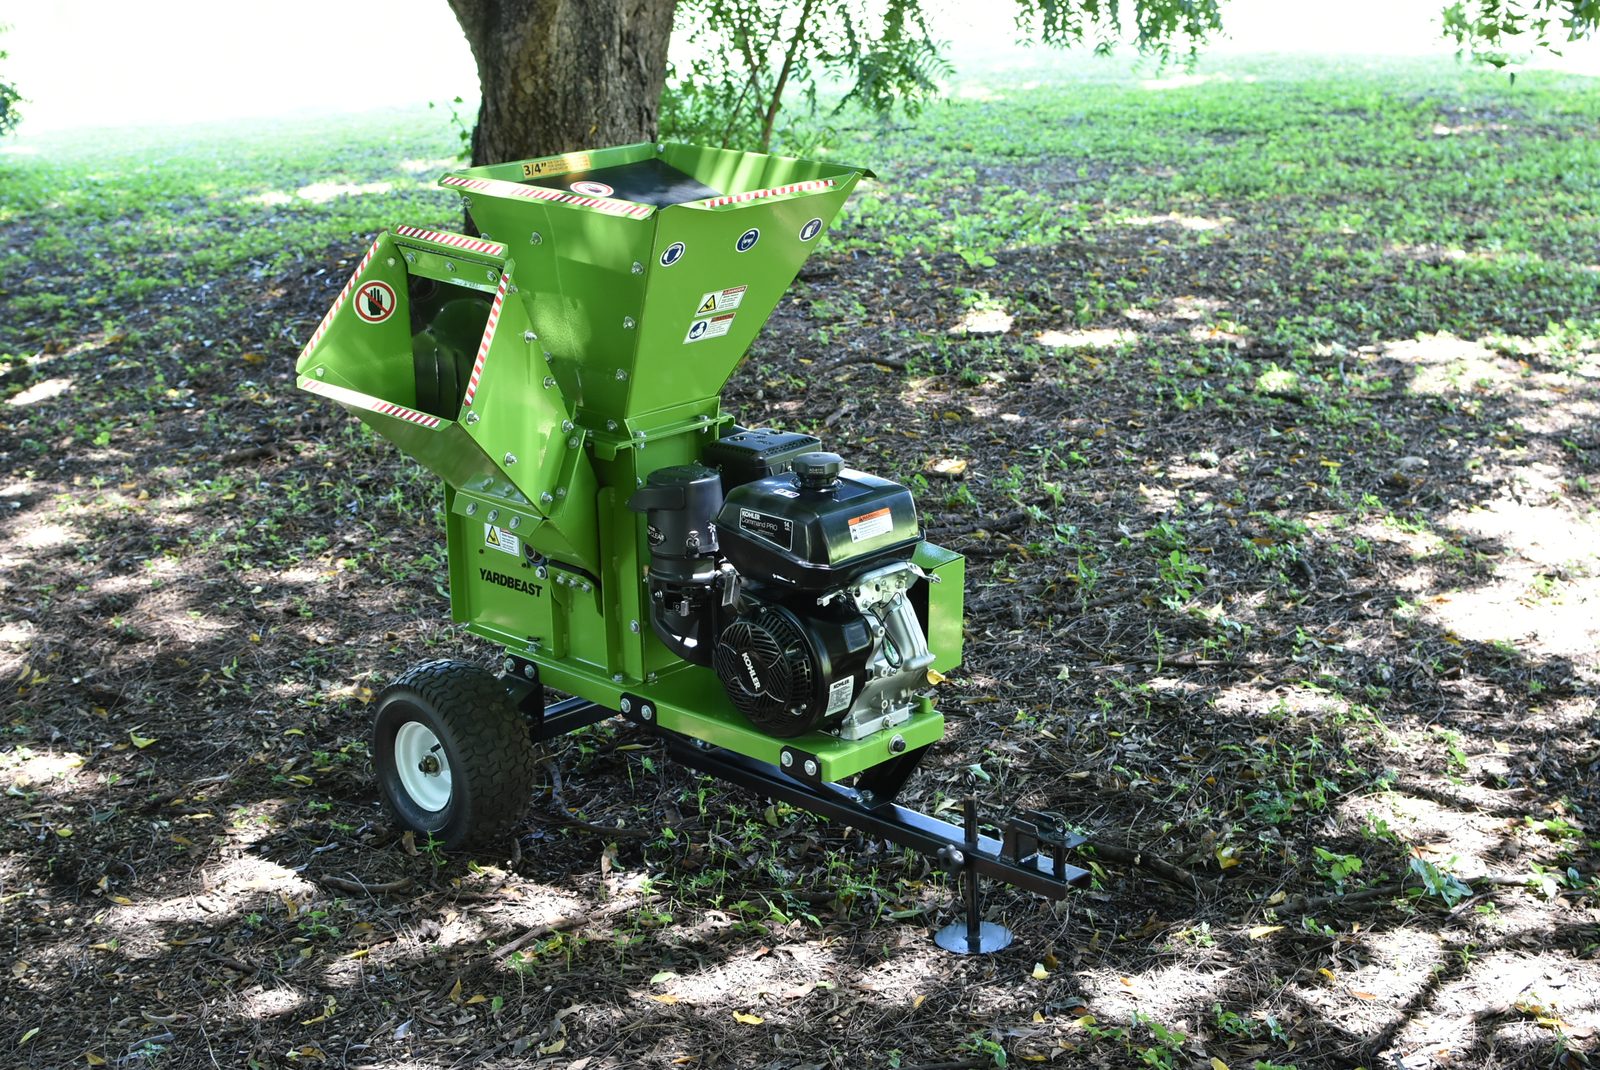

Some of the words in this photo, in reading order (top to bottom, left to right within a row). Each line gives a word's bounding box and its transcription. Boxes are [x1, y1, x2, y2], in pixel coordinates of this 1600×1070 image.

[741, 510, 761, 521] KOHLER
[741, 517, 766, 529] Command
[766, 522, 778, 531] PRO
[479, 568, 543, 597] YARDBEAST
[741, 652, 761, 691] KOHLER
[833, 679, 850, 688] KOHLER
